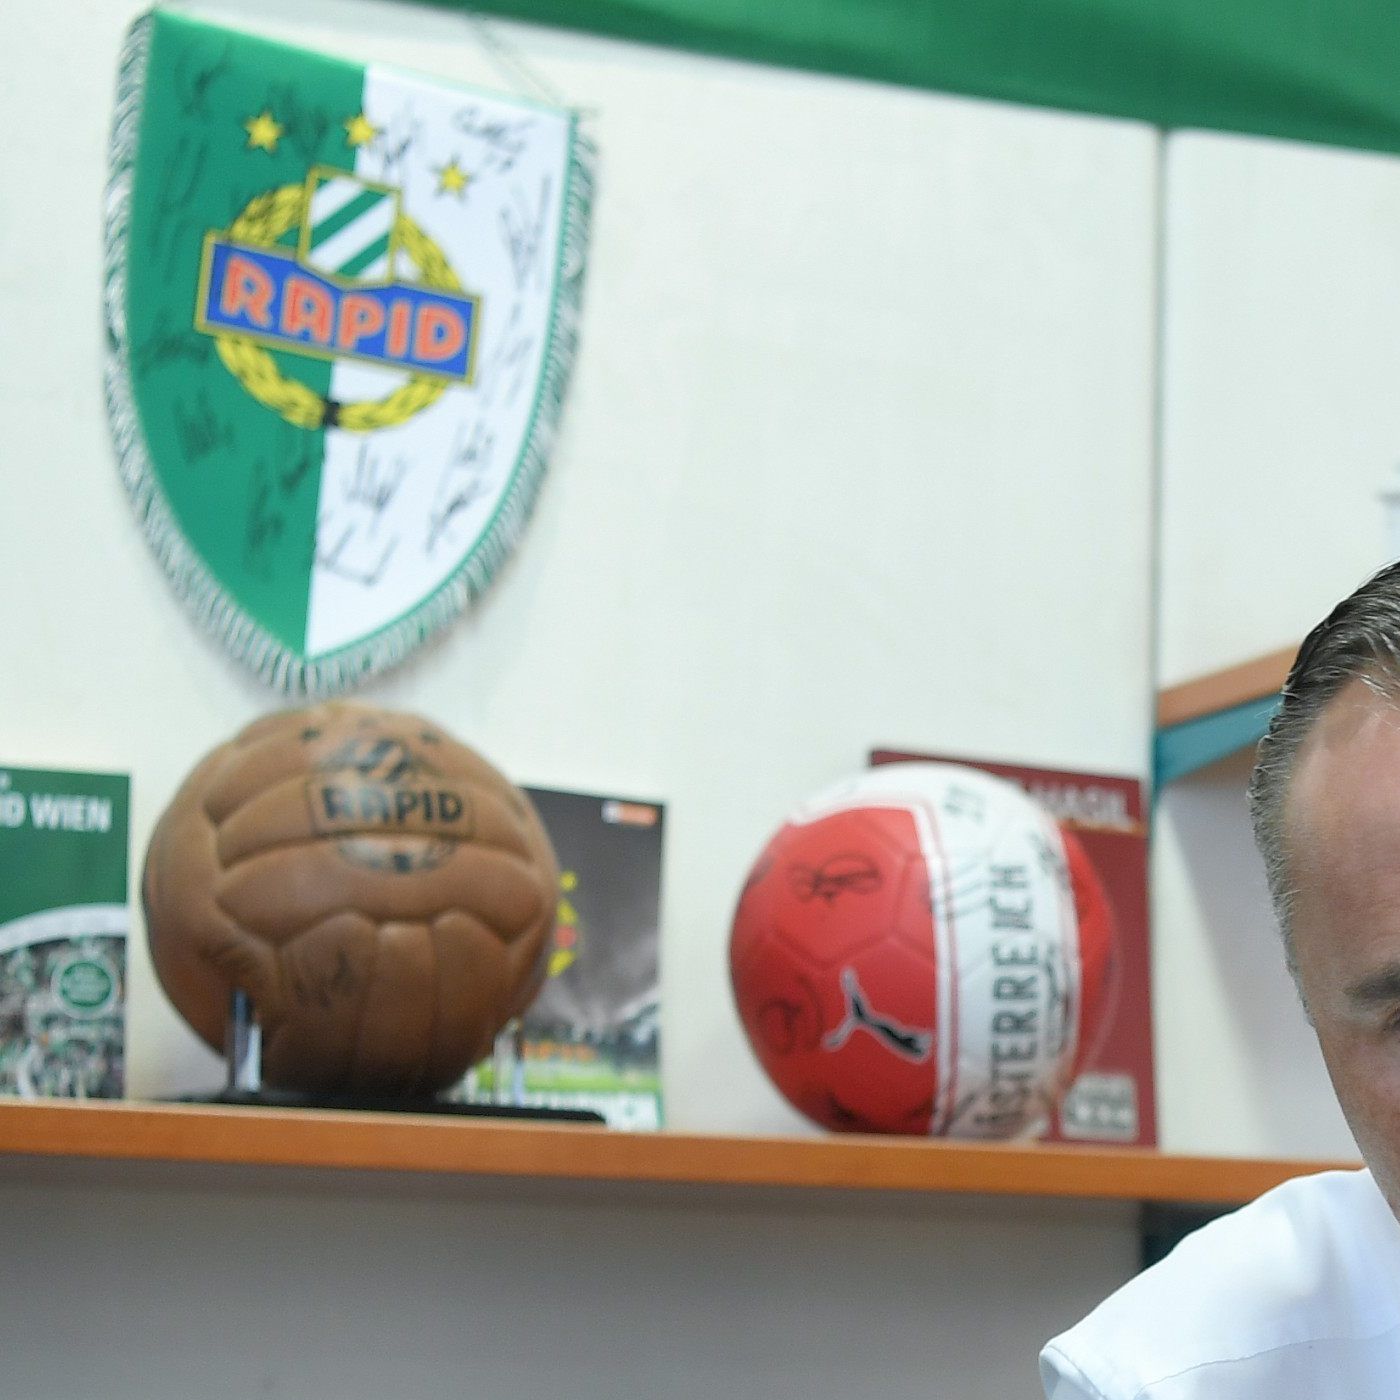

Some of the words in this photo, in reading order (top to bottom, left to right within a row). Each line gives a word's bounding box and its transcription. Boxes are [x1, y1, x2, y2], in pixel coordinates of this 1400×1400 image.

[219, 254, 465, 361] RAPID
[29, 793, 111, 832] WIEN
[321, 784, 463, 824] RAPID
